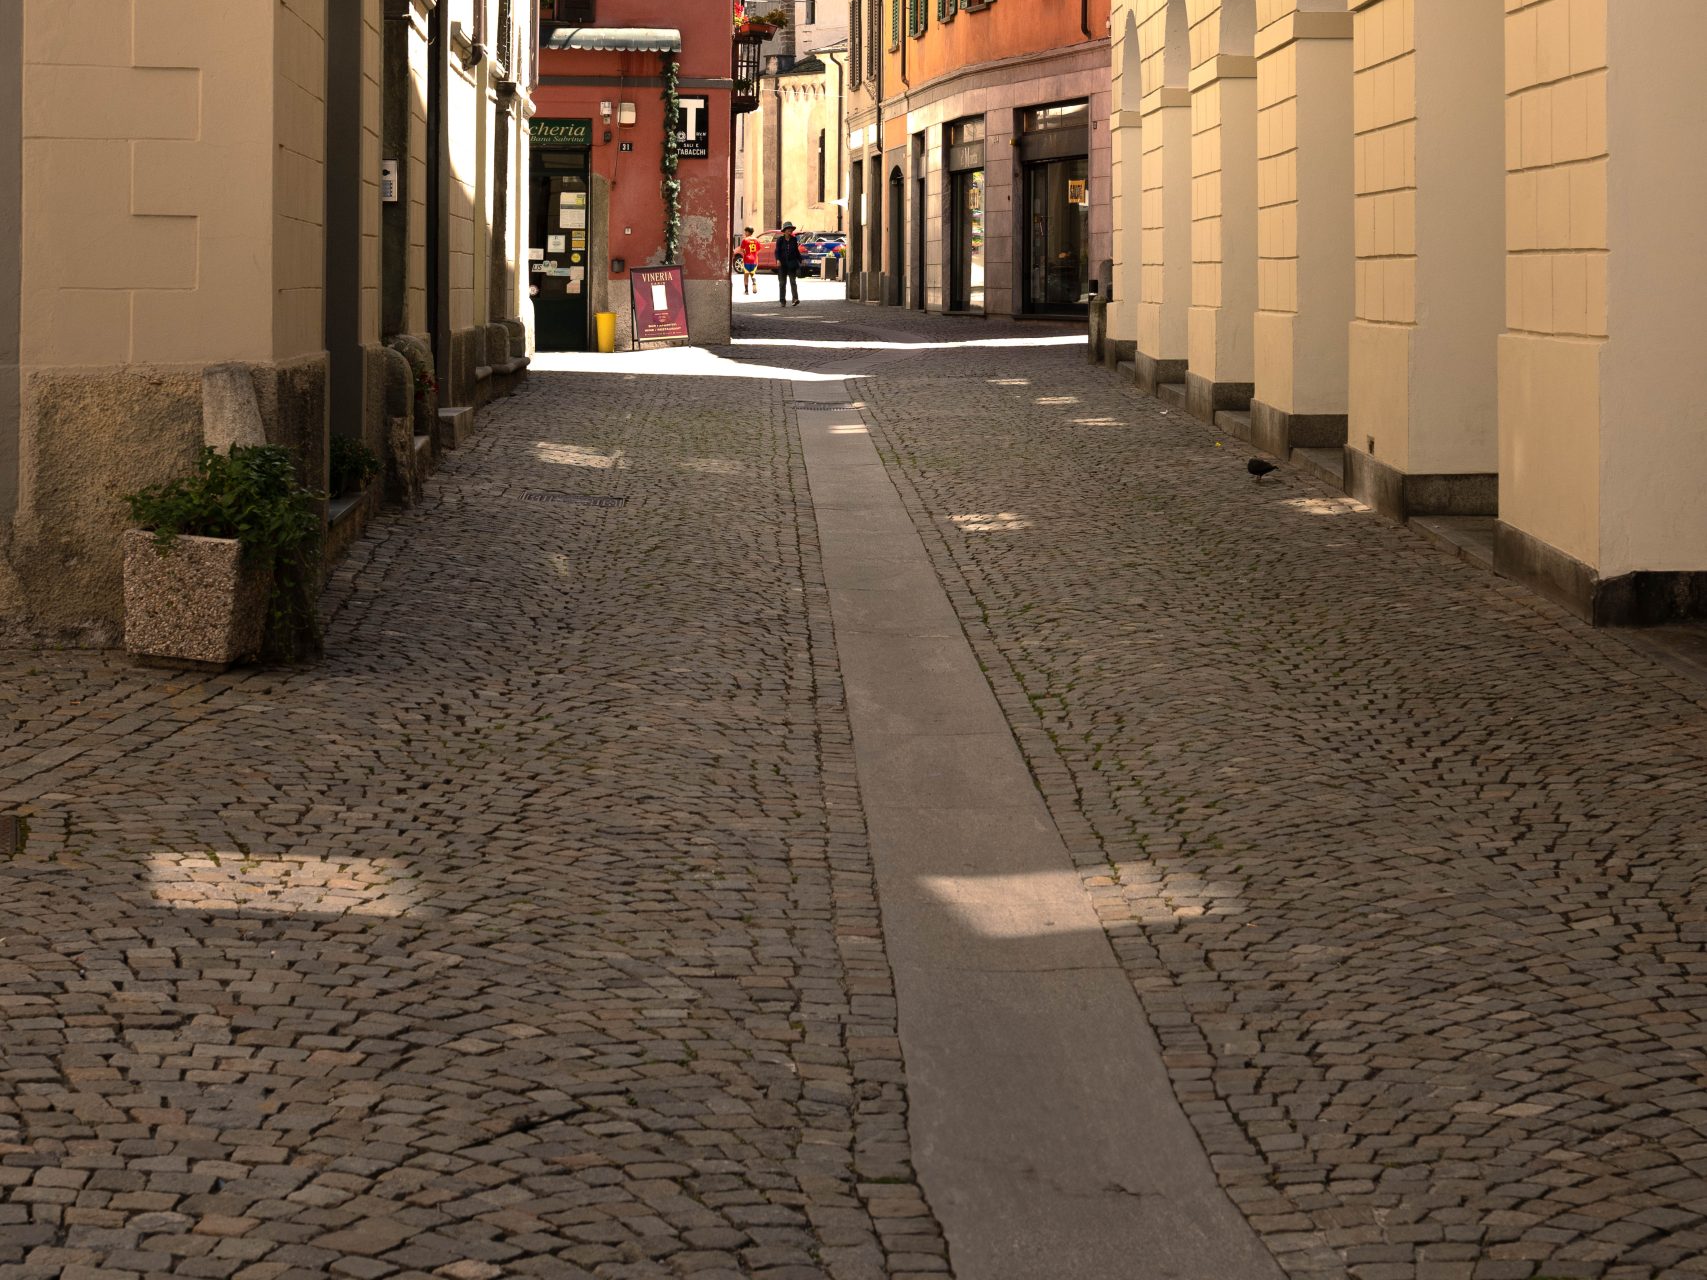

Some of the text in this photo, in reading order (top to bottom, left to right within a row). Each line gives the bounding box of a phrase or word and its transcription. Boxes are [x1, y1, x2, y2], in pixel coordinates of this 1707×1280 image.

[679, 98, 704, 140] T
[529, 122, 586, 136] cheria
[677, 148, 706, 156] TABACCHI
[641, 271, 673, 282] VINERIA
